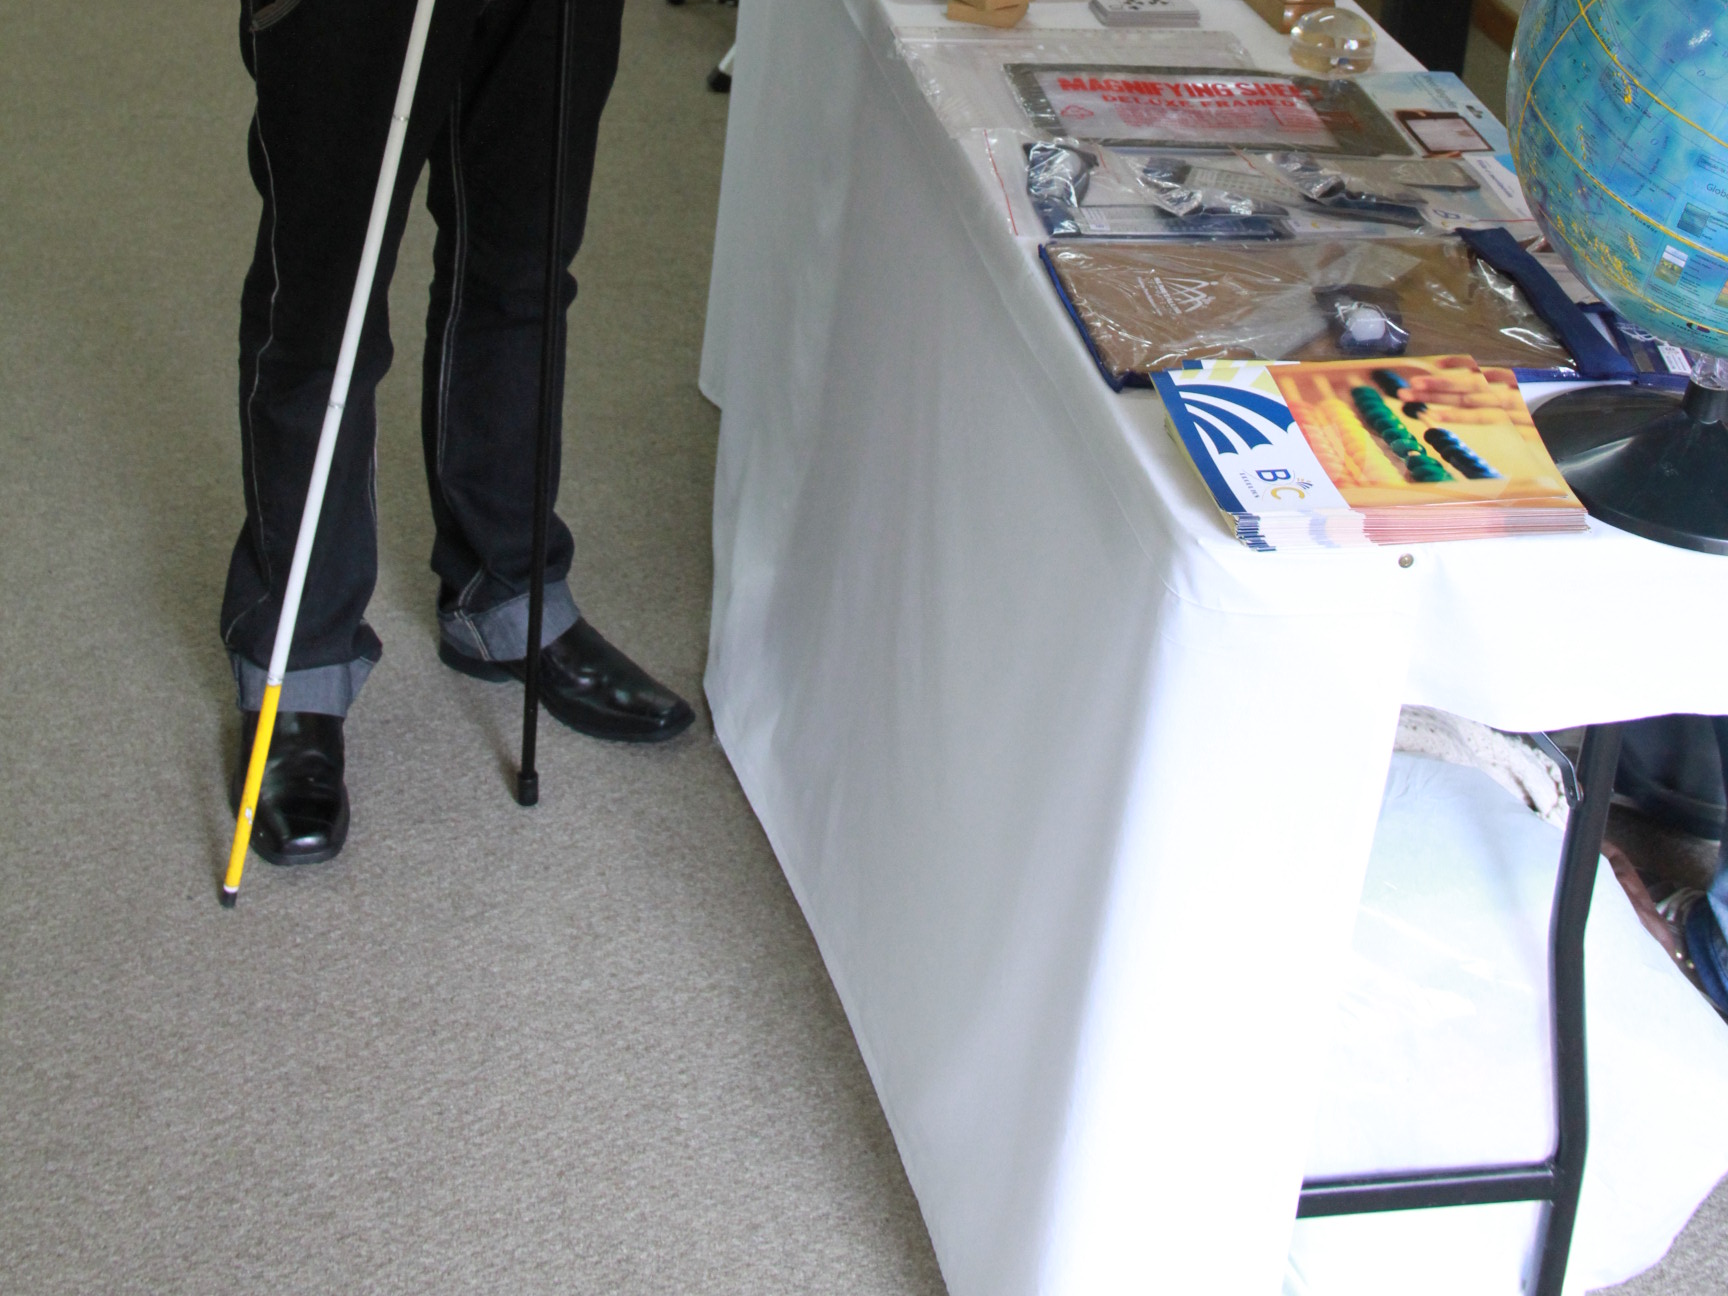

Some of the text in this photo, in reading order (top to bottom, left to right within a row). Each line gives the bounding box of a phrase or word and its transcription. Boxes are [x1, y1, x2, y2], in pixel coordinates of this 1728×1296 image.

[1057, 77, 1235, 98] MAGNIFYING
[1102, 94, 1297, 109] DELUXE FRAMED
